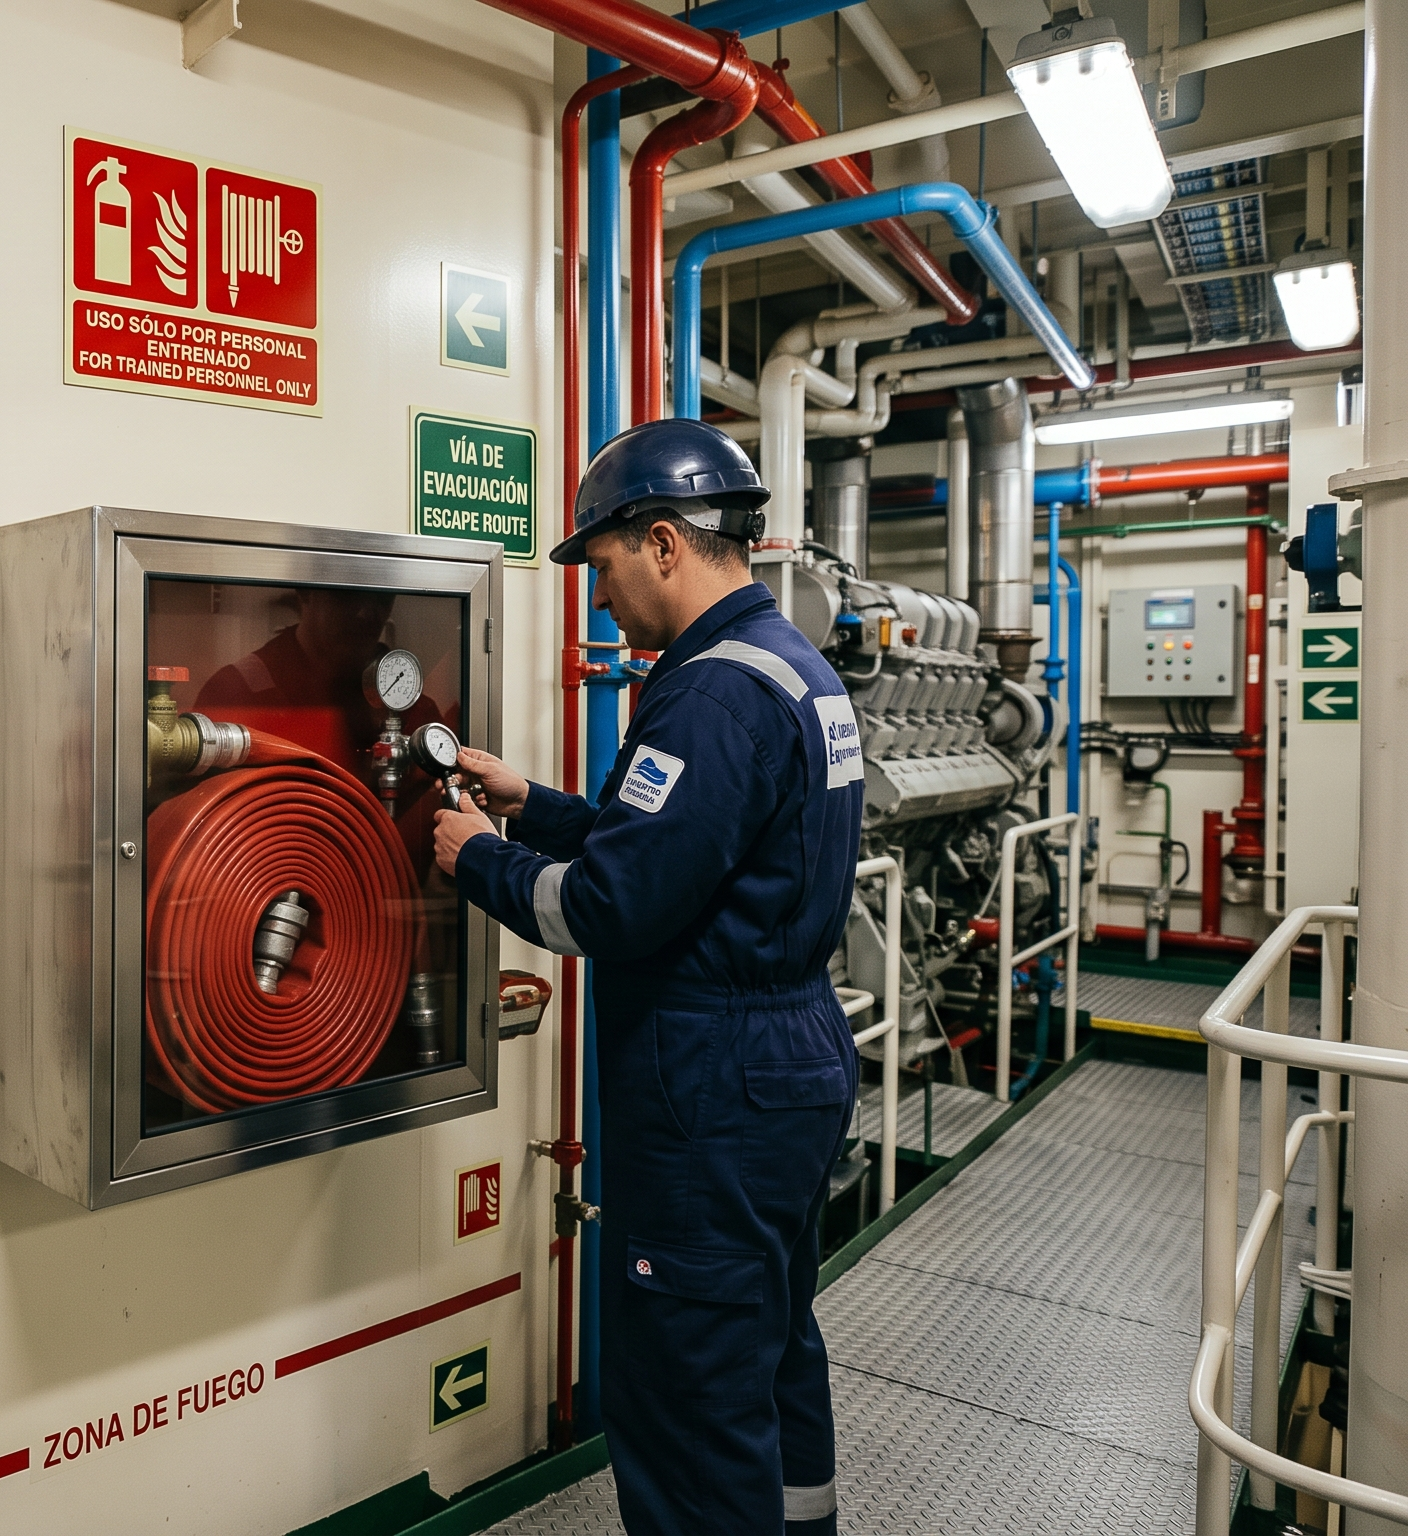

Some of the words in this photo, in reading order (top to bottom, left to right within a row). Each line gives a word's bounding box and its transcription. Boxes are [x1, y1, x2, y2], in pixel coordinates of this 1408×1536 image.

[86, 309, 124, 331] USO
[129, 314, 177, 339] SÓLO
[181, 324, 217, 345] POR
[221, 331, 307, 360] PERSONAL
[147, 340, 251, 370] ENTRENADO
[79, 350, 112, 371] FOR
[116, 355, 183, 380] TRAINED
[186, 366, 272, 393] PERSONNEL
[276, 379, 312, 398] ONLY
[449, 435, 478, 466] VÍA
[482, 443, 504, 469] DE
[423, 470, 528, 506] EVACUACIÓN
[423, 506, 480, 532] ESCAPE
[482, 513, 528, 537] ROUTE
[44, 1412, 125, 1469] ZONA
[133, 1394, 169, 1437] DE
[177, 1362, 265, 1420] FUEGO
